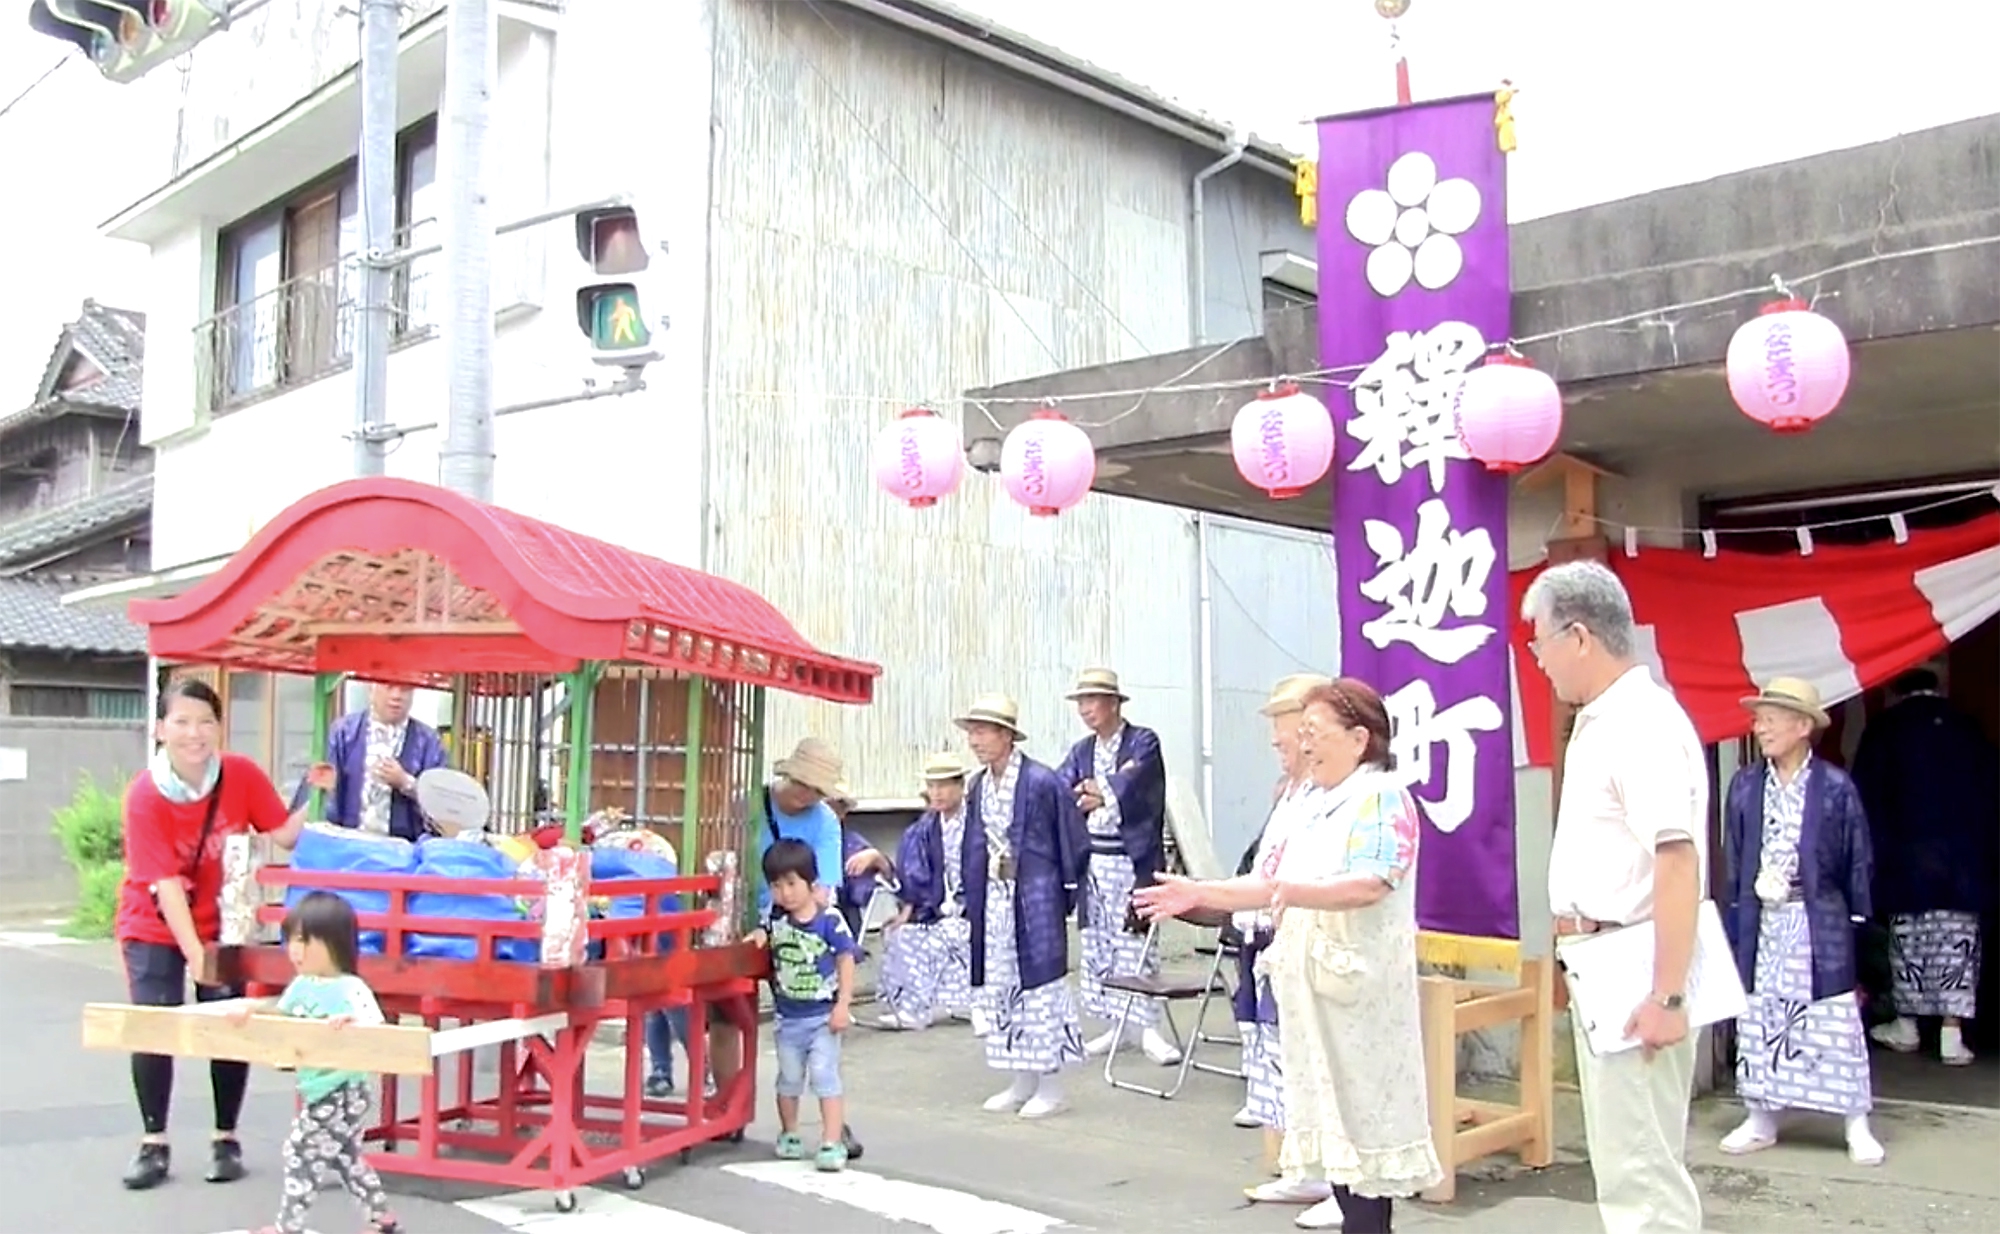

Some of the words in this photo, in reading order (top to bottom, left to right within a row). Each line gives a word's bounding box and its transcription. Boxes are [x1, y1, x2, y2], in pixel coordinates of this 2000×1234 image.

[1763, 323, 1796, 406] みなとまつり
[1023, 430, 1045, 496] なとまつり
[1260, 410, 1289, 484] みなとまつり
[1347, 321, 1503, 834] 釋迦町
